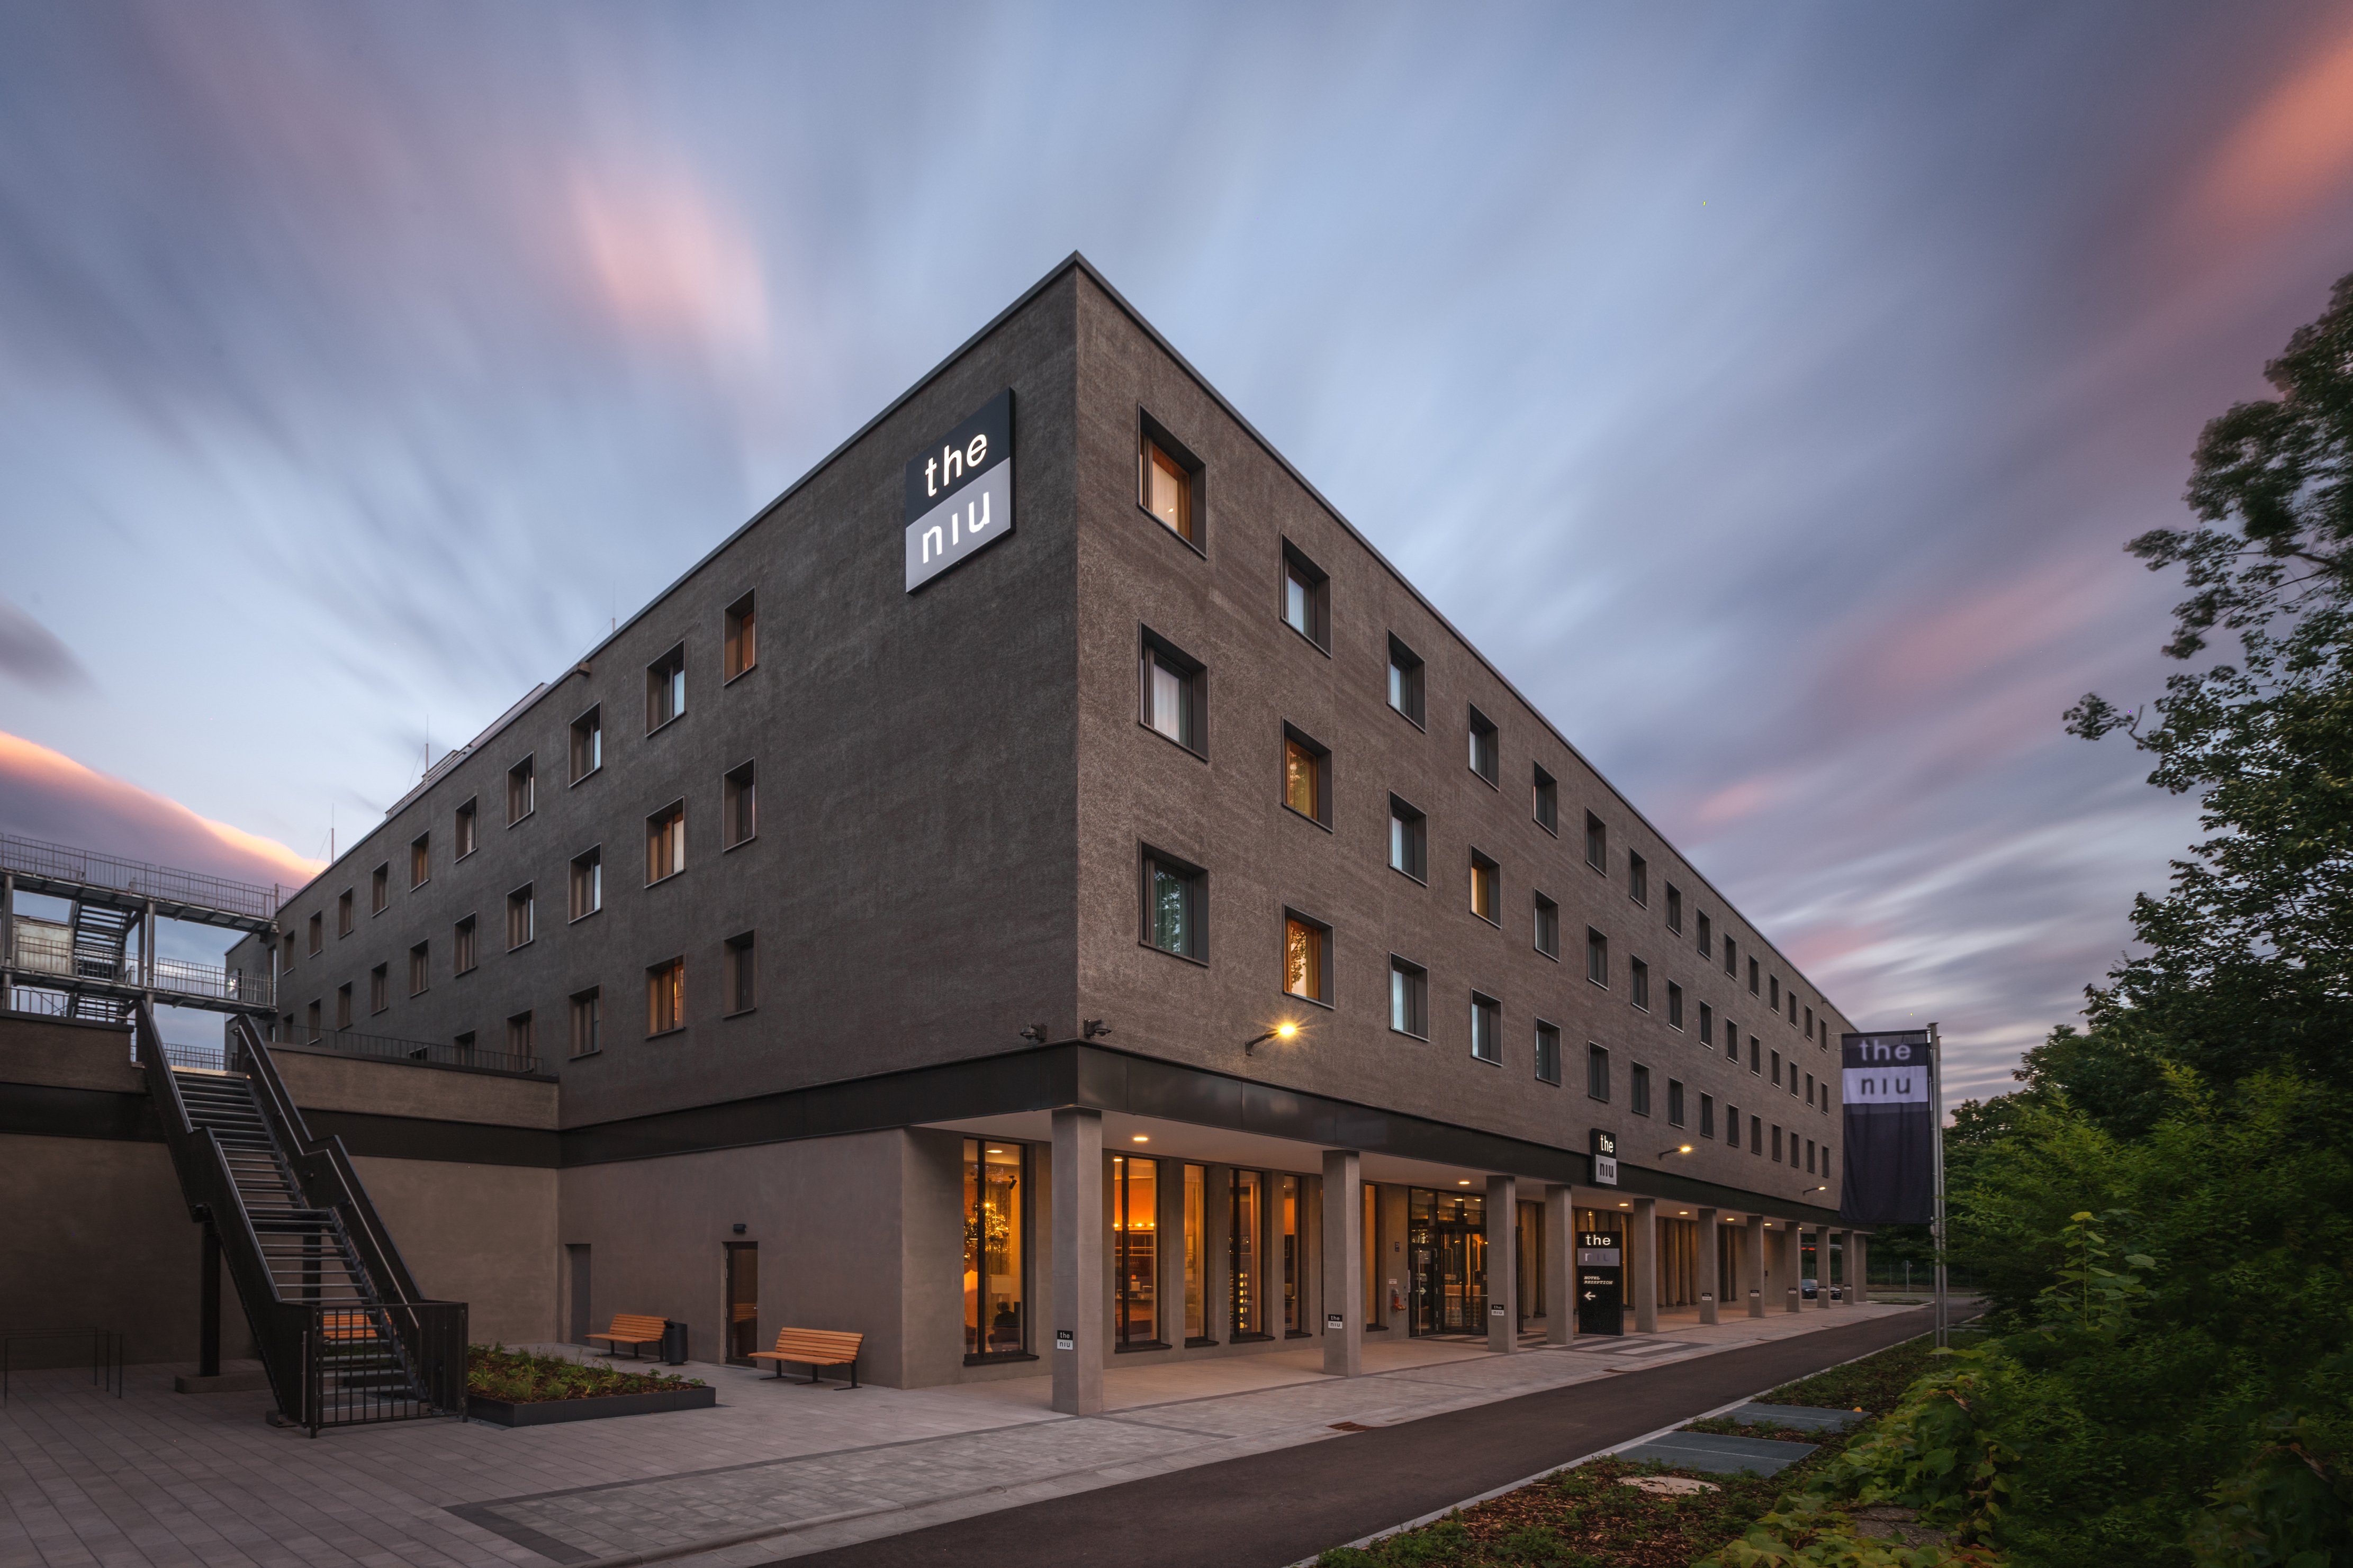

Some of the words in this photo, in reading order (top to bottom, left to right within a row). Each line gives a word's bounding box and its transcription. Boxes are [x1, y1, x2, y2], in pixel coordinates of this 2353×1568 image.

[925, 433, 987, 497] the
[922, 492, 990, 564] niu
[1859, 1039, 1912, 1061] the
[1861, 1077, 1910, 1095] niu
[1600, 1134, 1613, 1153] the
[1600, 1163, 1613, 1178] niu
[1585, 1235, 1611, 1245] the
[1585, 1253, 1611, 1262] niu
